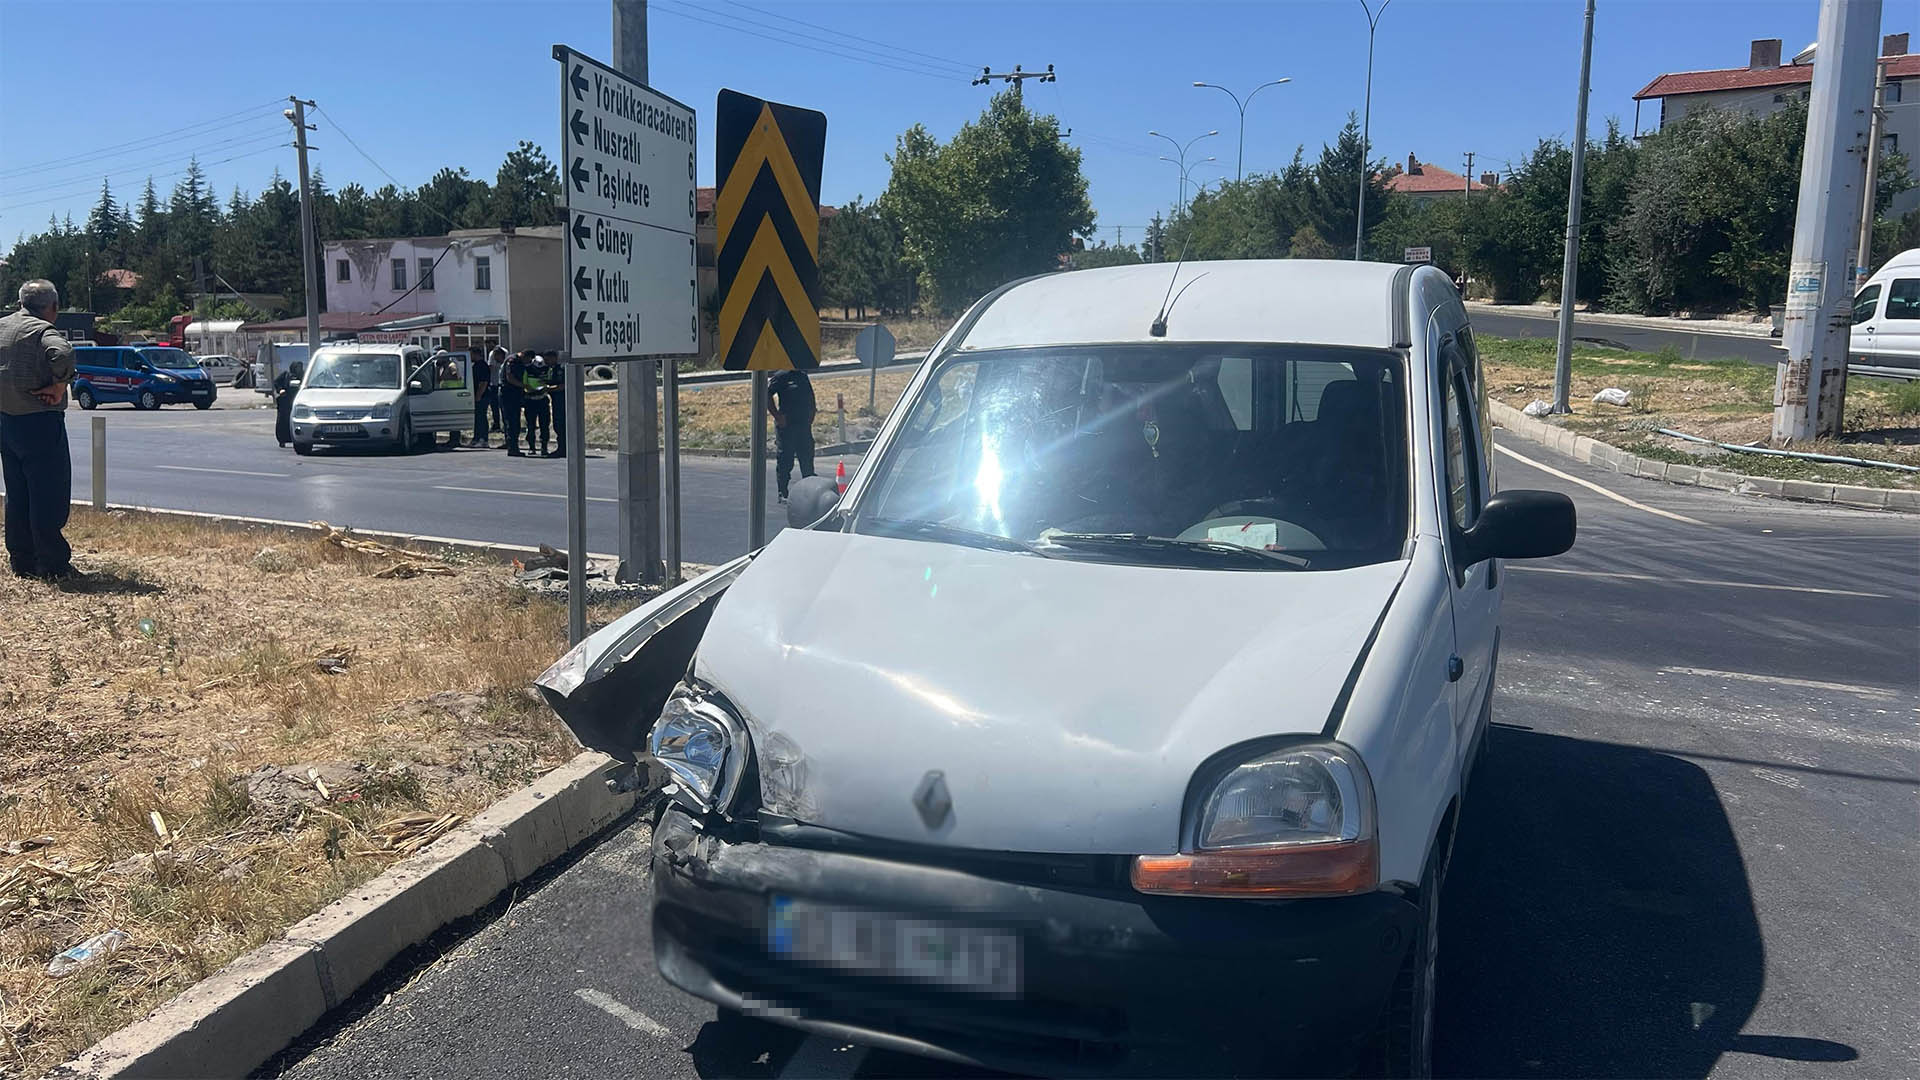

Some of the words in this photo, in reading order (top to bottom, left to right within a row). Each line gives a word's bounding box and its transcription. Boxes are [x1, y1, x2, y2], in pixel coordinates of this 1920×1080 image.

[594, 72, 687, 143] Yörükkaracaören
[688, 116, 694, 145] 6
[594, 116, 641, 165] Nusratlı
[688, 152, 694, 181] 6
[594, 162, 650, 209] Taşlıdere
[689, 190, 695, 219] 6
[596, 217, 633, 264] Güney
[689, 239, 695, 267] 7
[597, 268, 629, 304] Kutlu
[690, 280, 696, 307] 7
[597, 311, 640, 353] Taşağıl
[691, 315, 697, 343] 9
